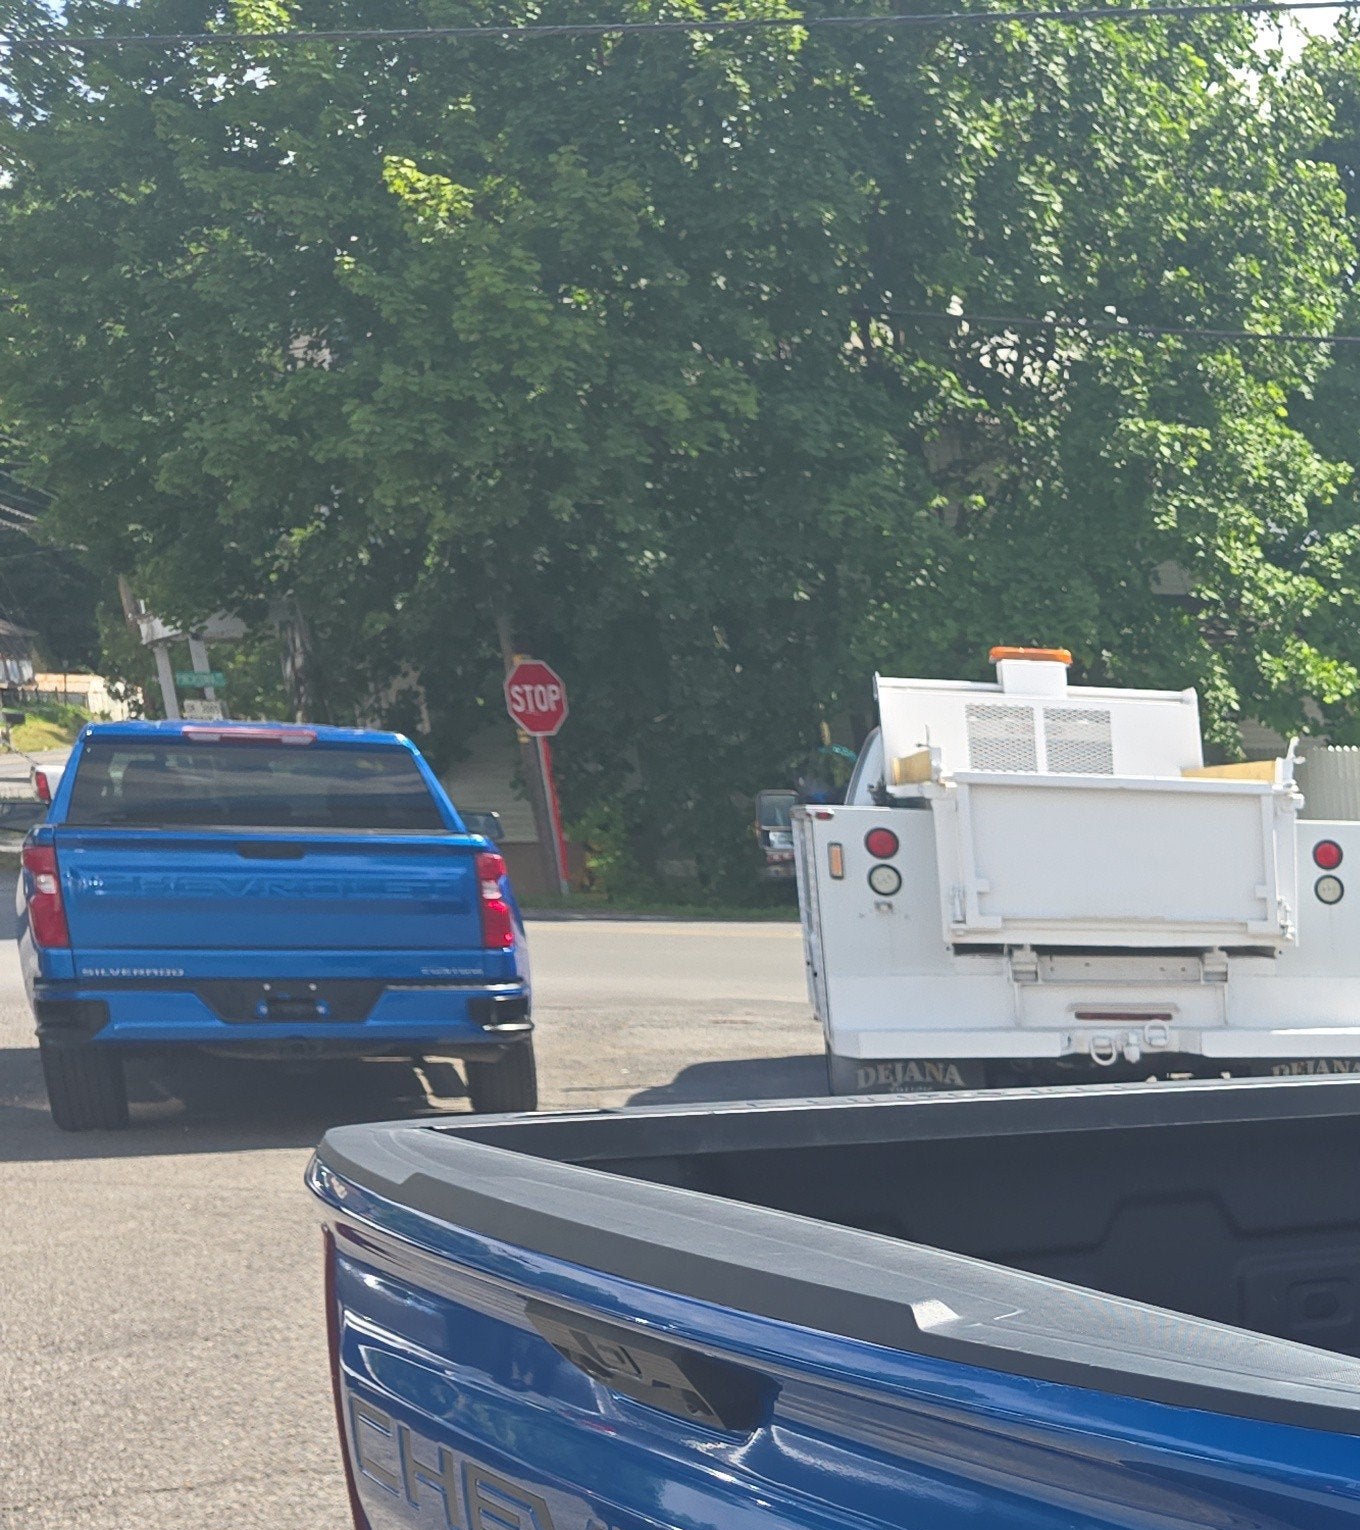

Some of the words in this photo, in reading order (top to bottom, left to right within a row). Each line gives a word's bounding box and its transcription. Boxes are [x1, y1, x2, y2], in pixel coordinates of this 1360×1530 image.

[510, 684, 561, 713] STOP
[82, 967, 184, 977] SILVERADO
[858, 1061, 966, 1088] DEJANA
